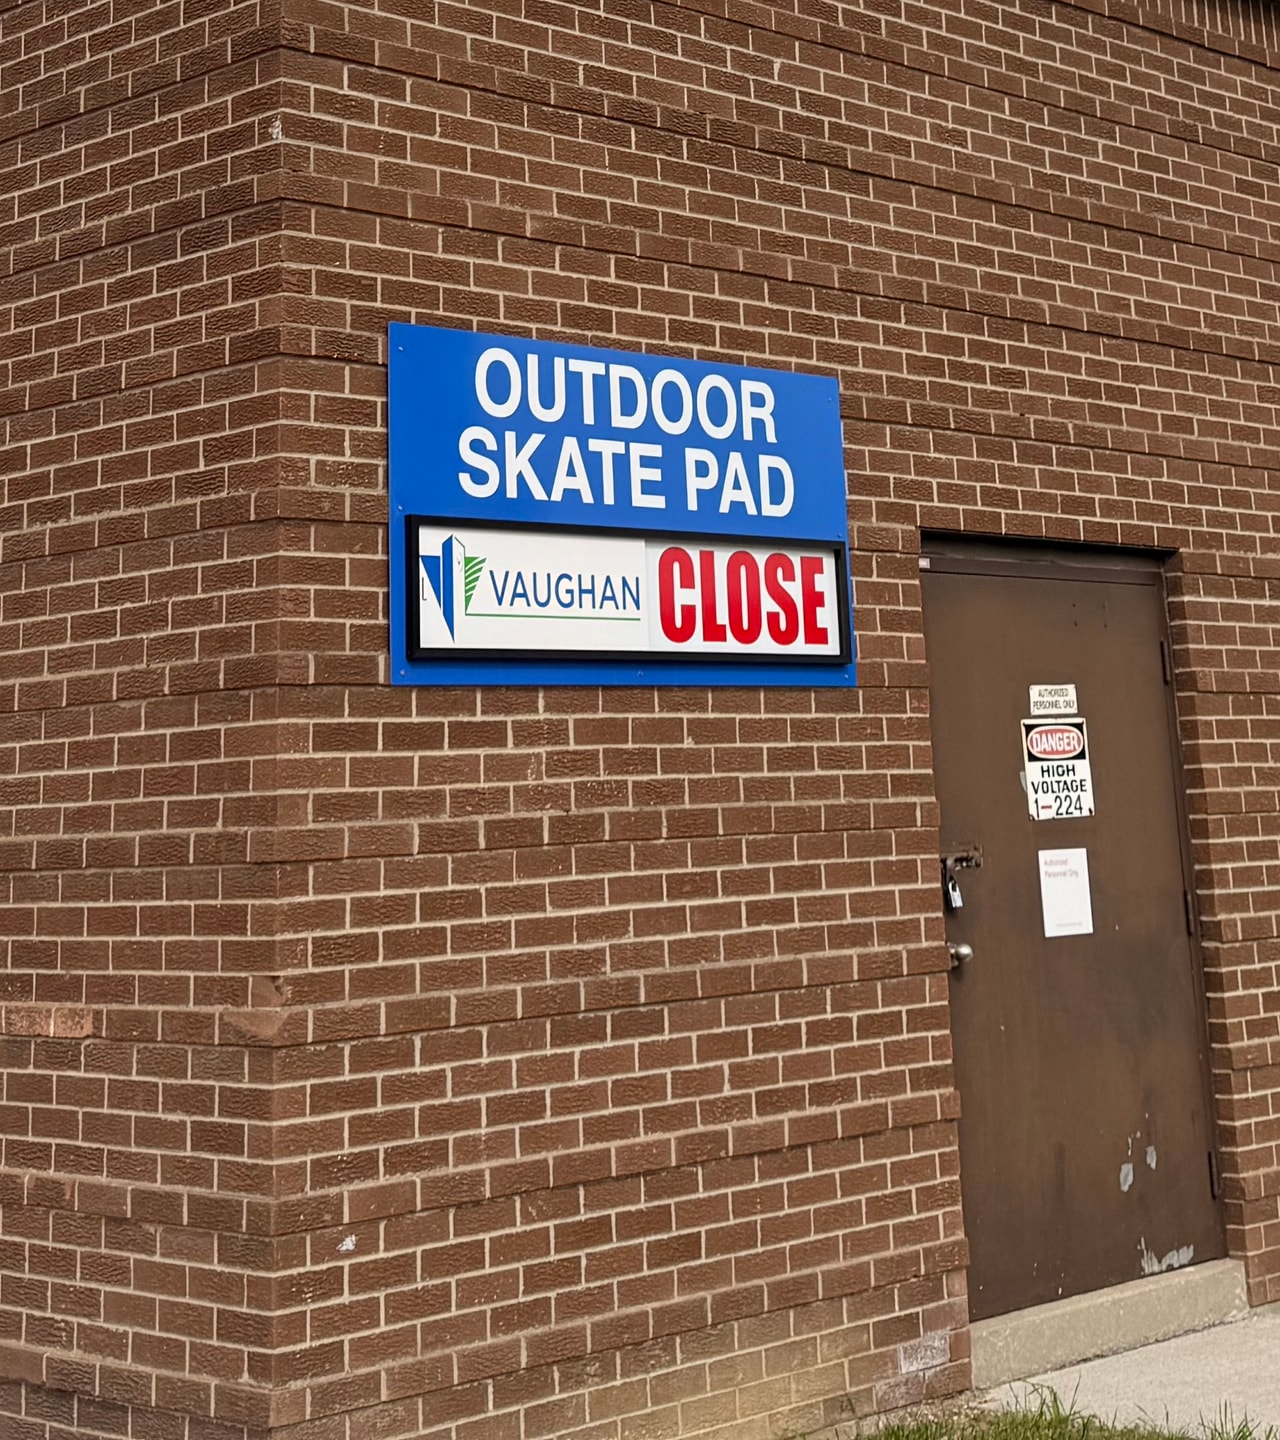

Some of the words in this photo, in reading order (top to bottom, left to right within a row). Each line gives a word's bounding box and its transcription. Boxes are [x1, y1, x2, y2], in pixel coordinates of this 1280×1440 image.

[474, 347, 778, 444] OUTDOOR
[457, 425, 666, 510] SKATE
[684, 447, 795, 517] PAD
[488, 569, 641, 611] VAUGHAN
[658, 546, 829, 645] CLOSE
[1038, 687, 1069, 698] AUTHORIZED
[1032, 699, 1062, 711] PERSONNEL
[1031, 731, 1079, 752] DANGER
[1040, 763, 1076, 778] HIGH
[1031, 779, 1087, 795] VOLTAGE
[1034, 794, 1083, 819] 1-224
